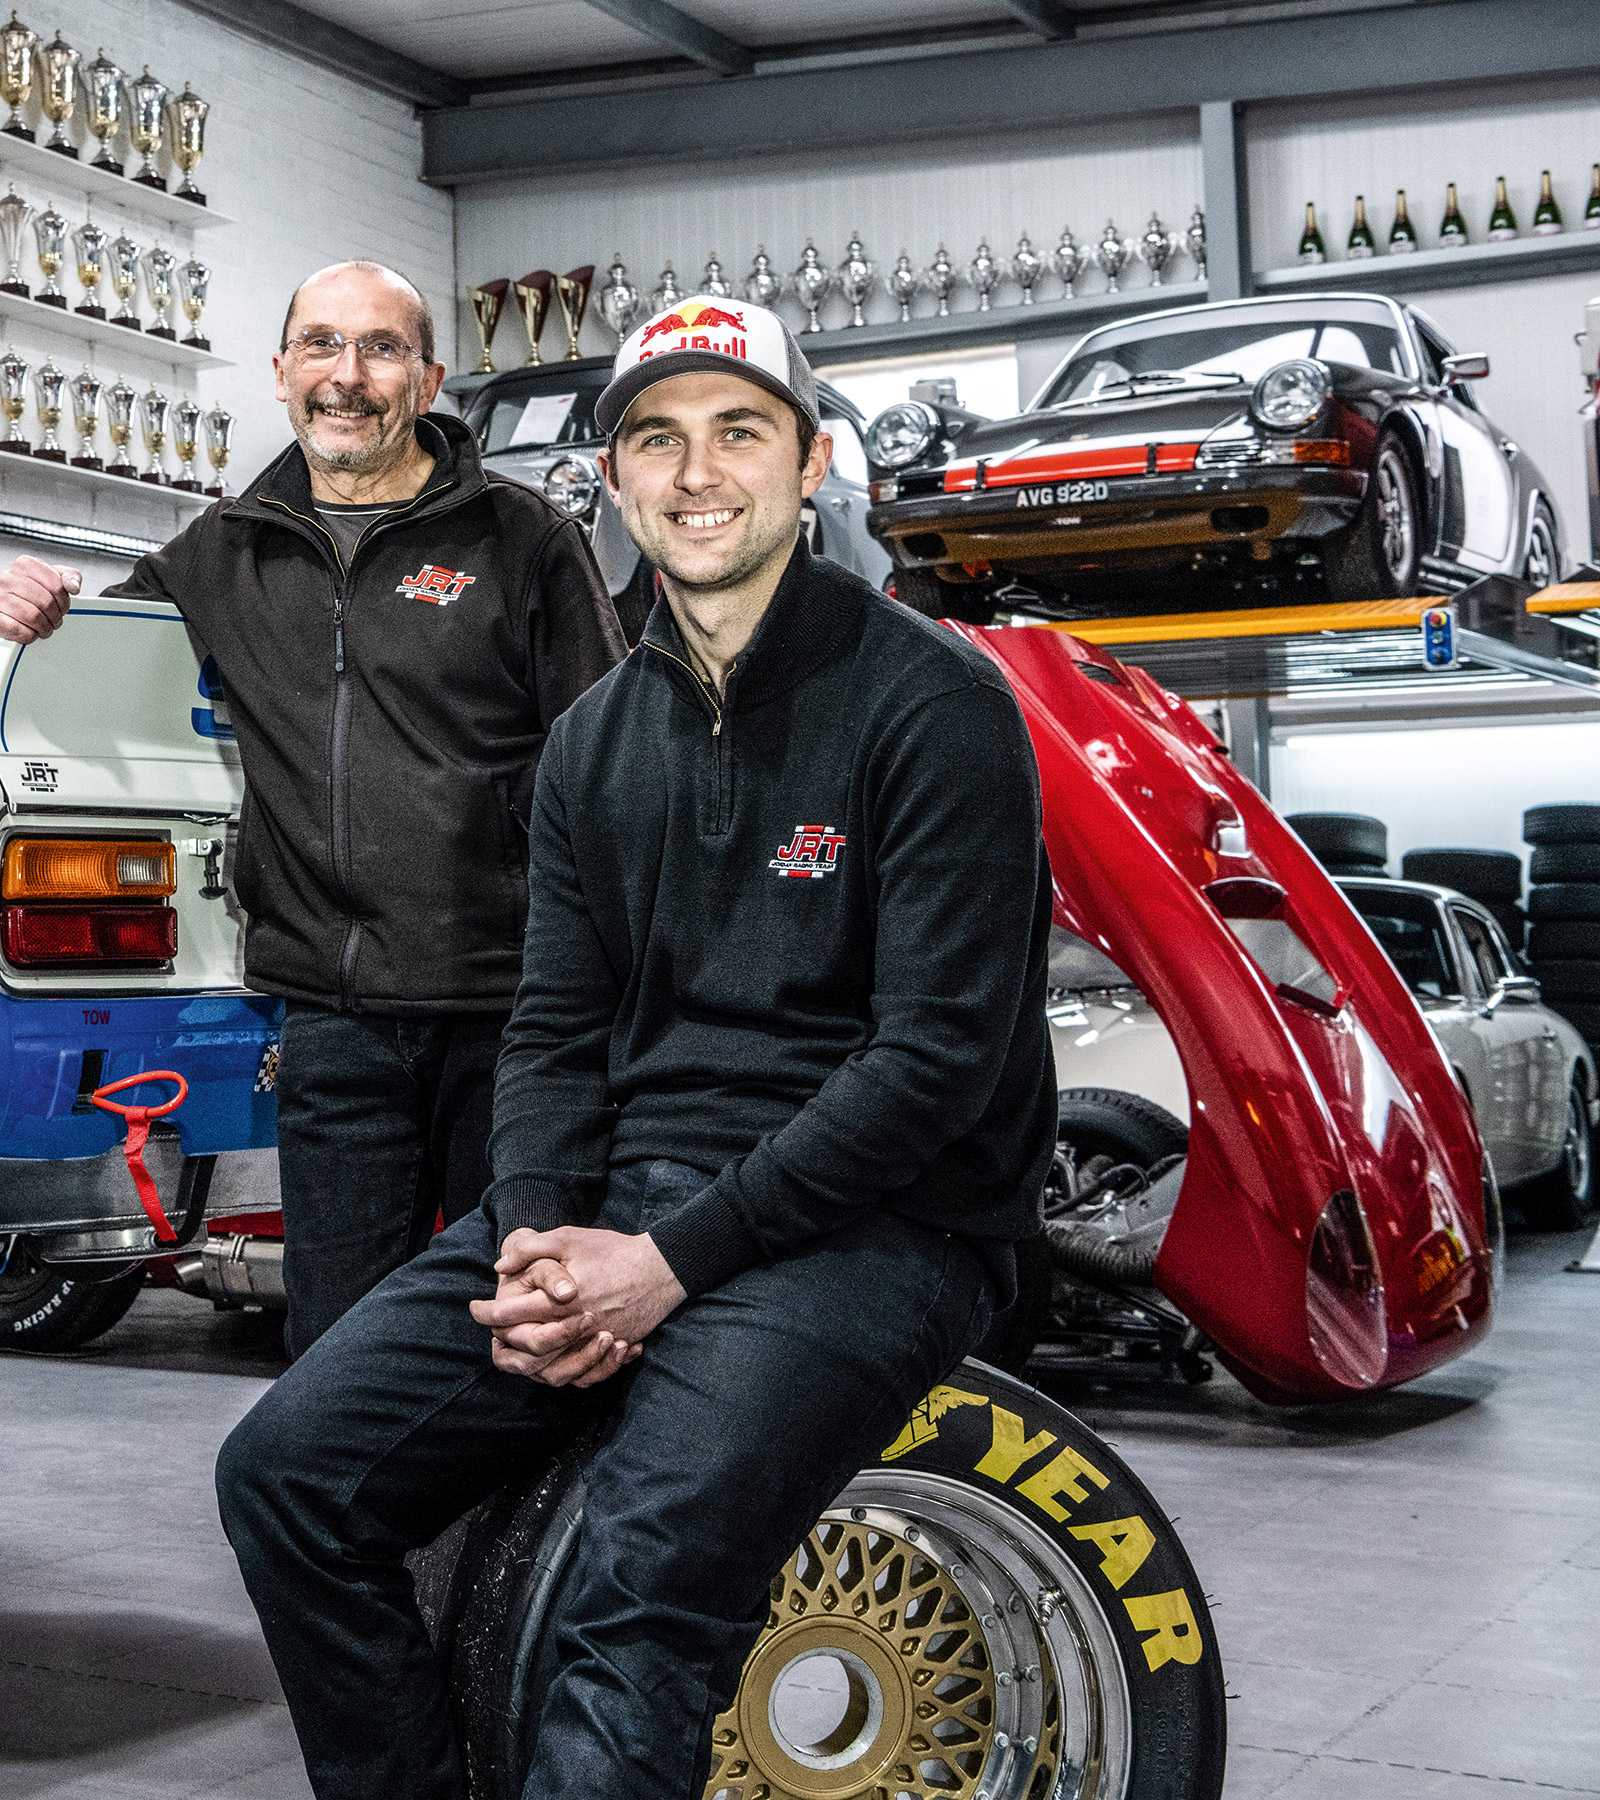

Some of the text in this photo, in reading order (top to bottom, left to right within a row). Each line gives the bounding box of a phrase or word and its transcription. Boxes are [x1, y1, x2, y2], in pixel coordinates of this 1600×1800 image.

[1016, 481, 1108, 508] AVG 922D
[402, 569, 477, 594] JRT
[20, 767, 59, 783] JRT
[777, 833, 847, 862] JRT
[82, 1010, 110, 1025] TOW
[14, 1294, 62, 1331] RACING
[974, 1403, 1203, 1672] YEAR
